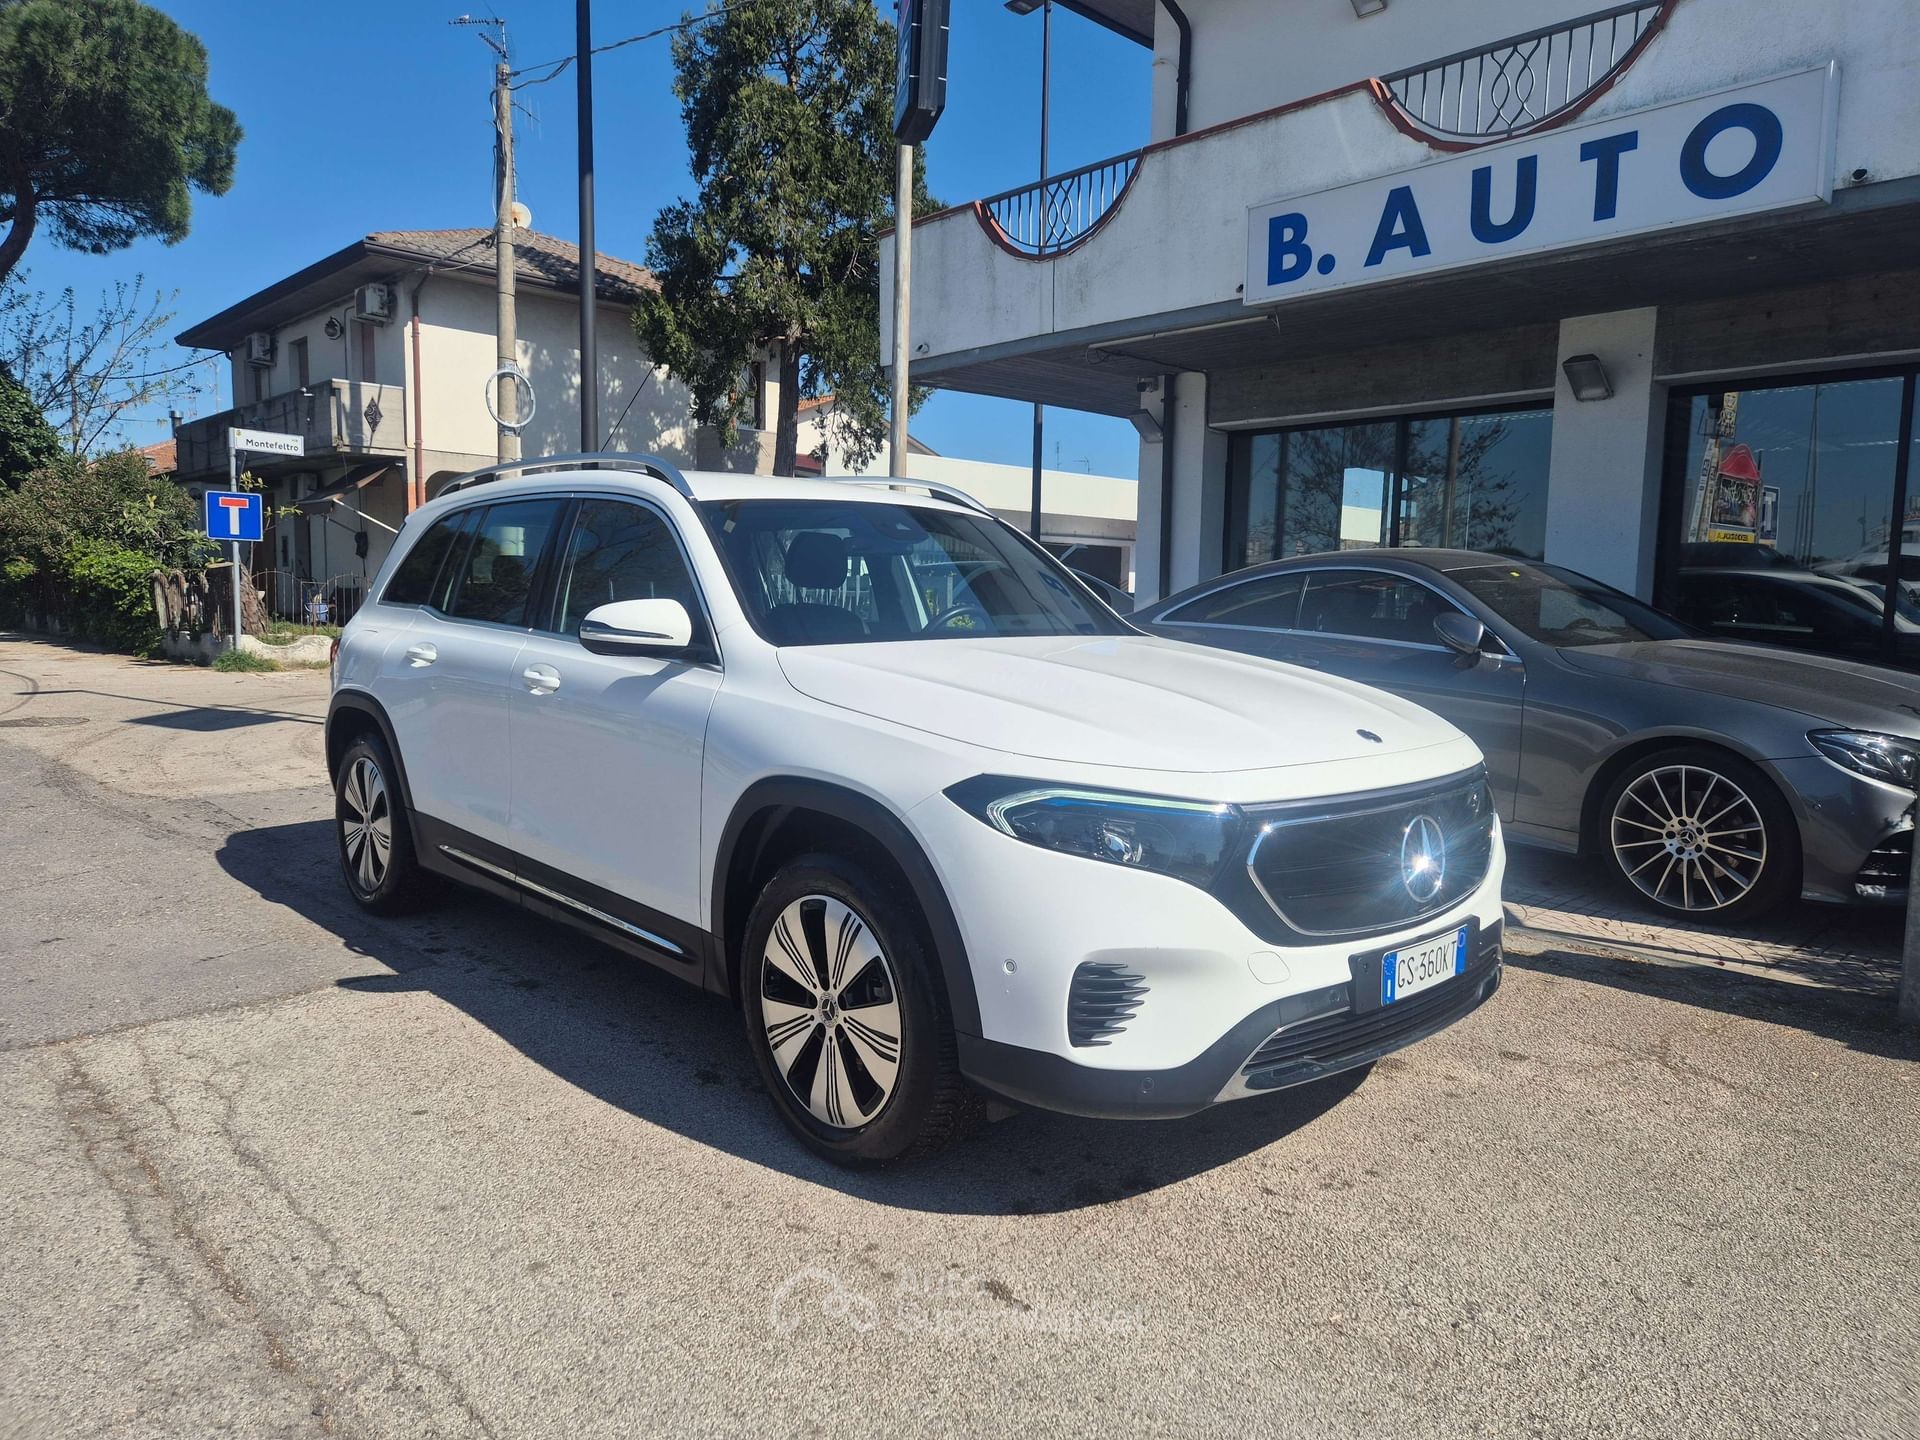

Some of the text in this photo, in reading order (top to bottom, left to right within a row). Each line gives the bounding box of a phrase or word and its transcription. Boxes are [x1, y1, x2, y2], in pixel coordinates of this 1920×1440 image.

[1267, 103, 1784, 286] B. AUTO
[246, 438, 299, 452] Montefeltro
